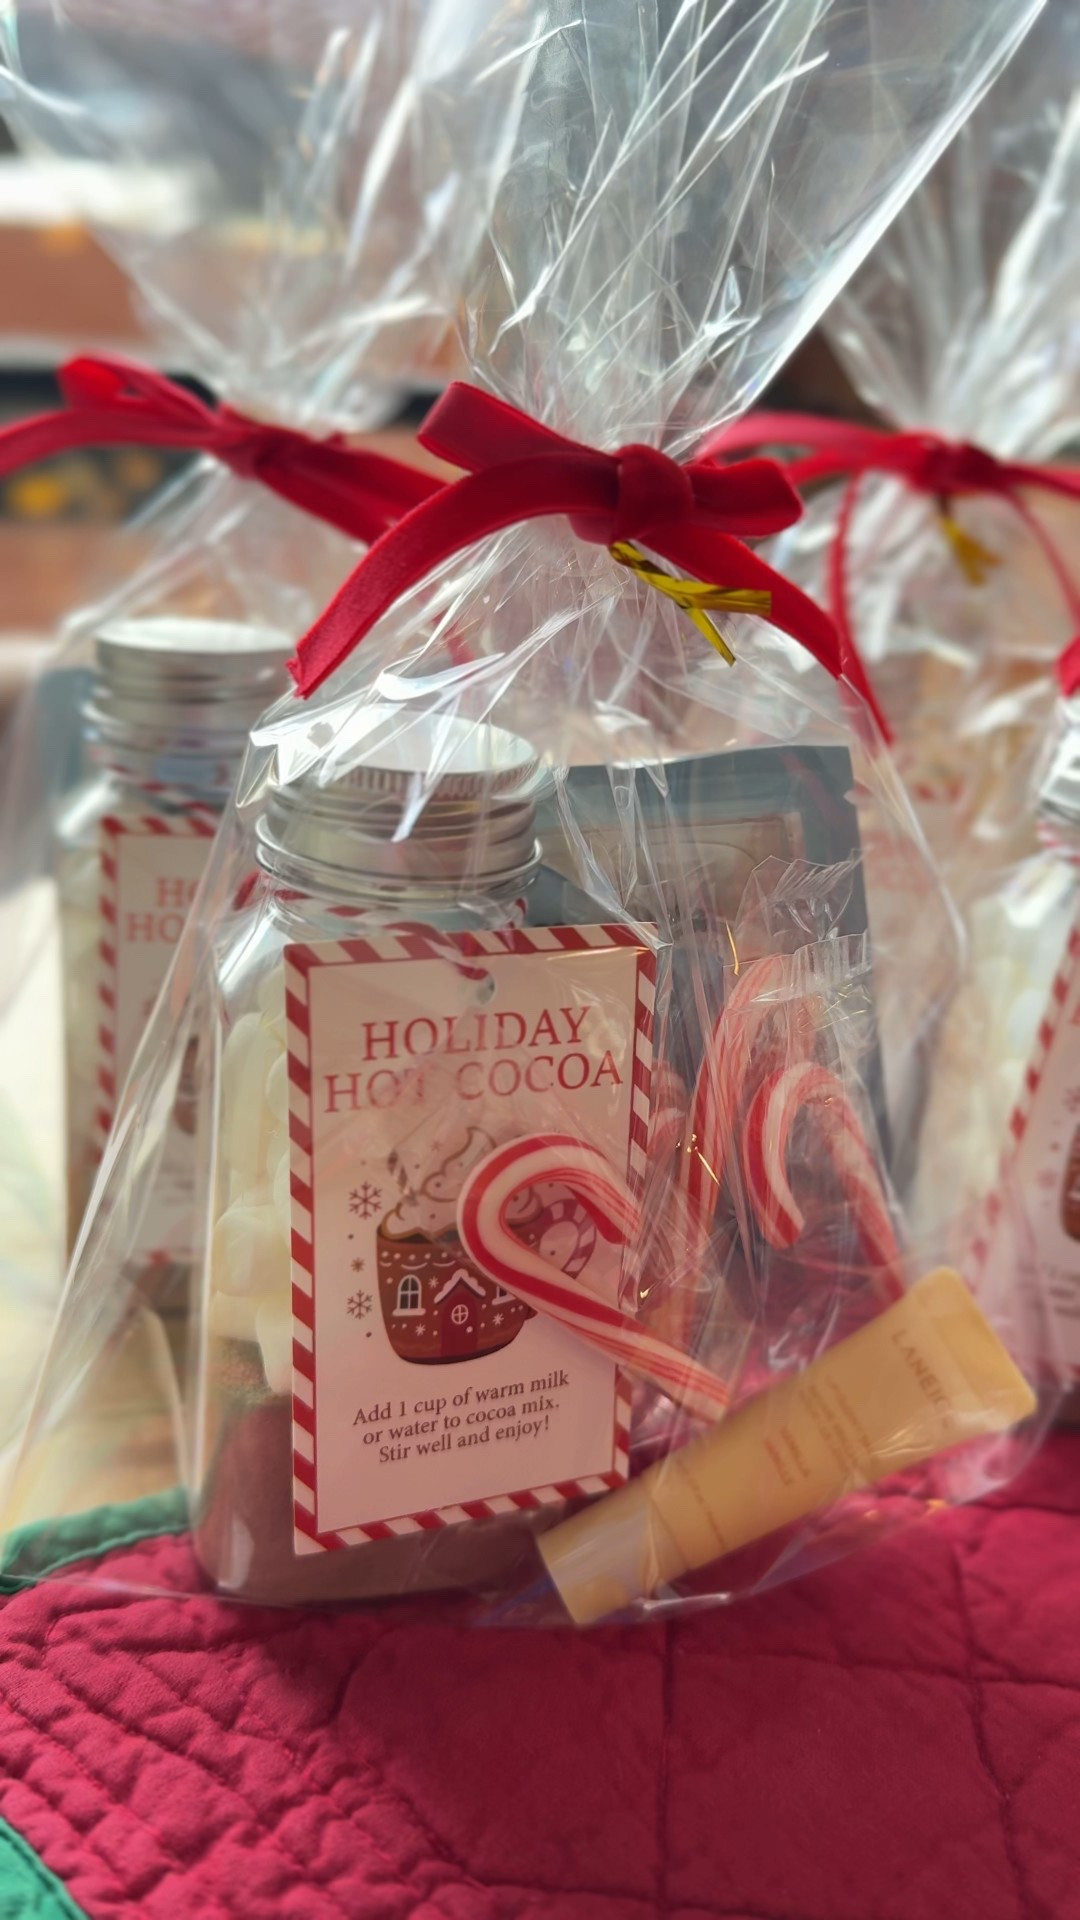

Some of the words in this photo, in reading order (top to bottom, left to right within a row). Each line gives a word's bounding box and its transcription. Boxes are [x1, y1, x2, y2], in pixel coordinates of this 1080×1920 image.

[361, 1006, 591, 1061] HOLIDAY
[323, 1066, 427, 1113] HOT
[455, 1050, 623, 1101] COCOA
[352, 1402, 392, 1426] Add
[399, 1401, 407, 1417] 1
[413, 1397, 448, 1415] cup
[452, 1386, 474, 1407] of
[475, 1382, 525, 1402] warm
[529, 1369, 570, 1392] milk
[362, 1430, 384, 1445] or
[388, 1419, 439, 1440] water
[443, 1415, 461, 1430] to
[466, 1405, 517, 1425] cocoa
[521, 1395, 560, 1416] mix.
[379, 1443, 412, 1464] Stir
[416, 1433, 452, 1456] well
[456, 1425, 491, 1448] and
[495, 1414, 550, 1442] enjoy!
